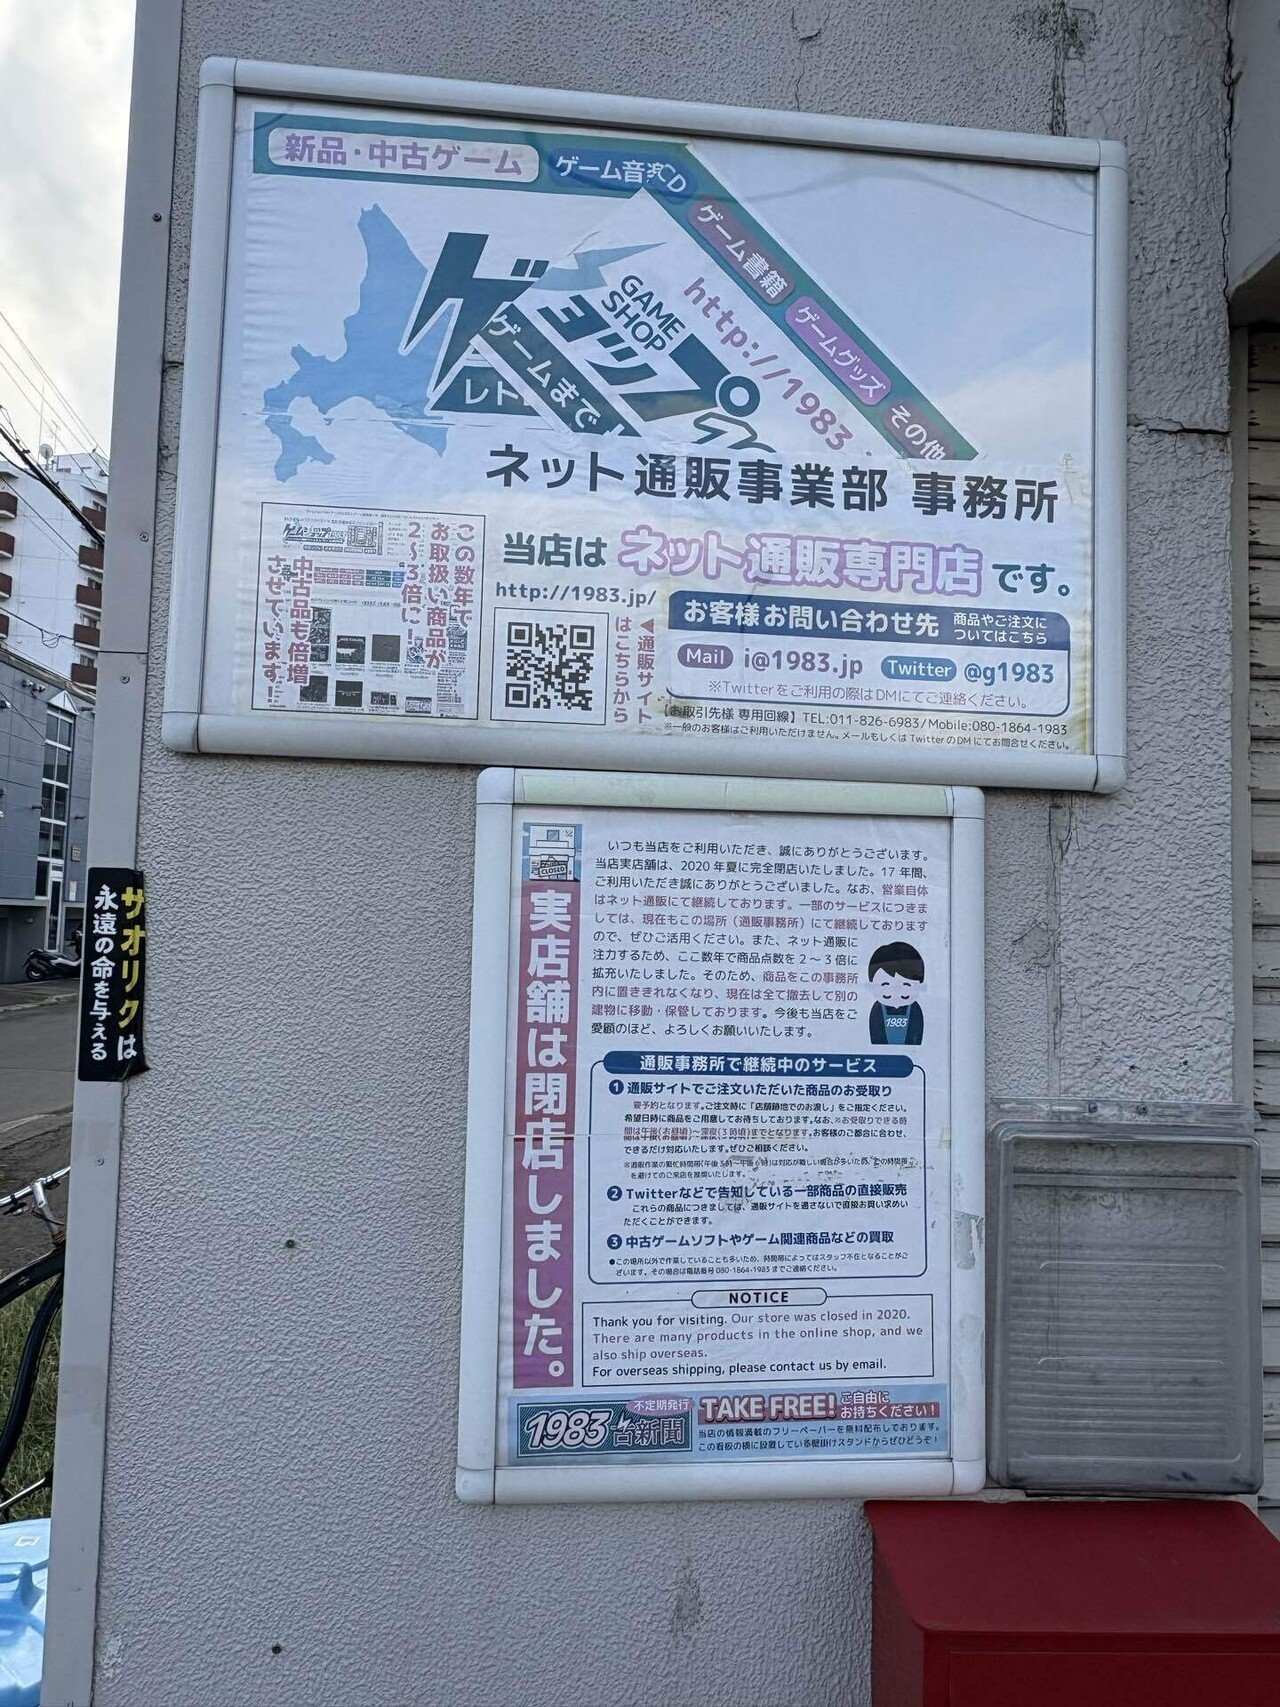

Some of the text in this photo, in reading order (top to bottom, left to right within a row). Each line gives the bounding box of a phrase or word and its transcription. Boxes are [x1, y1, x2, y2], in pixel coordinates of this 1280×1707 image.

[285, 132, 522, 176] 新品・中古ゲーム
[696, 204, 788, 299] ゲーム書籍
[600, 290, 666, 352] SHOP
[621, 274, 686, 341] GAME
[796, 305, 887, 399] ゲームグッズ
[464, 378, 530, 407] レト
[890, 404, 946, 461] その他
[486, 443, 1058, 524] ネット通販事業部 事務所
[453, 523, 476, 628] この数年で
[503, 524, 1070, 598] 当店は ネット通販専門店 です。
[425, 521, 450, 670] お取扱い商品が
[495, 581, 657, 608] http://1983.jp/
[287, 555, 313, 686] 中古品も倍増
[953, 611, 1047, 630] 商品やご注文に
[953, 629, 1048, 645] ついてはこちら
[613, 616, 632, 725] はこちらから
[637, 634, 655, 724] 通販サイト
[686, 647, 863, 680] Mail i@1983.jp
[887, 659, 1054, 687] Twitter @g1983
[89, 884, 119, 1061] 永遠の命を与える
[117, 886, 146, 1062] サオリクは
[884, 1017, 909, 1029] 1983
[639, 1055, 877, 1074] 通販事務所で継続中のサービス
[522, 889, 572, 1377] 実店舗は閉店しました。
[729, 1291, 789, 1304] NOTICE
[593, 1309, 910, 1329] Thank you for visiting. Our store was closed in 2020.
[593, 1326, 923, 1344] There are many products in the online shop, and we
[592, 1349, 708, 1362] also ship overseas.
[592, 1358, 887, 1378] For overseas shipping, please contact us by email.
[634, 1399, 690, 1412] 不定期発行
[699, 1391, 838, 1422] TAKE FREE!
[841, 1390, 889, 1405] ご自由に
[525, 1408, 613, 1450] 1983
